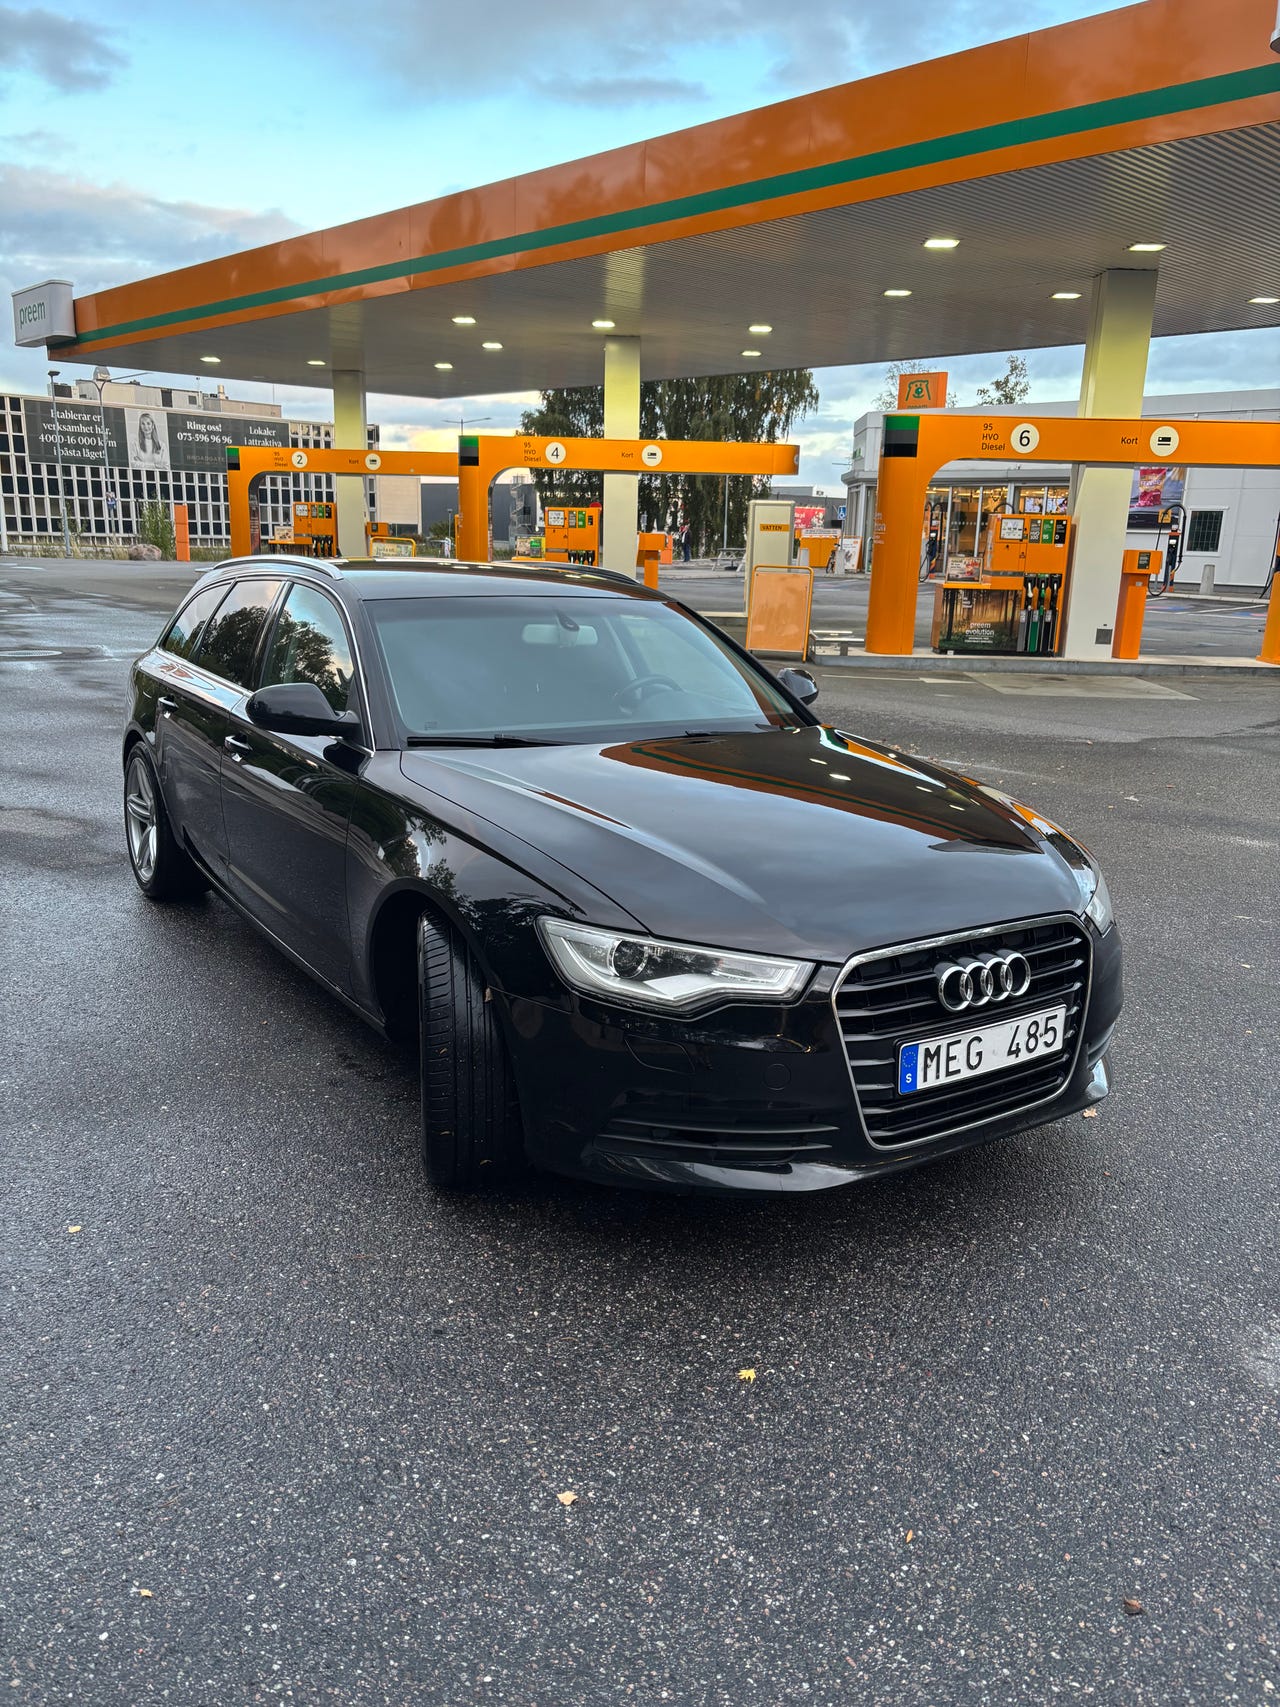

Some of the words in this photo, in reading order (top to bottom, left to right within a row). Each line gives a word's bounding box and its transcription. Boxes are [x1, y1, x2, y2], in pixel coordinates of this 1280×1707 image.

[19, 301, 46, 329] preem
[42, 422, 94, 434] verksamhet
[95, 424, 112, 435] hr.
[186, 421, 206, 432] Ring
[207, 424, 222, 432] oss!
[249, 426, 276, 436] Lokaler
[983, 423, 993, 431] 95
[39, 433, 77, 444] 4000-16
[77, 436, 96, 446] 000
[97, 436, 117, 447] km
[210, 434, 221, 444] 96
[221, 435, 232, 444] 96
[248, 437, 282, 447] attraktiva
[982, 433, 999, 441] HVO
[1019, 430, 1031, 446] 6
[1121, 437, 1138, 445] Kort
[53, 446, 57, 456] i
[981, 442, 1005, 451] Diesel
[551, 447, 559, 459] 4
[296, 454, 303, 465] 2
[923, 1035, 983, 1083] MEG
[1007, 1014, 1058, 1058] 485
[905, 1073, 912, 1083] S
